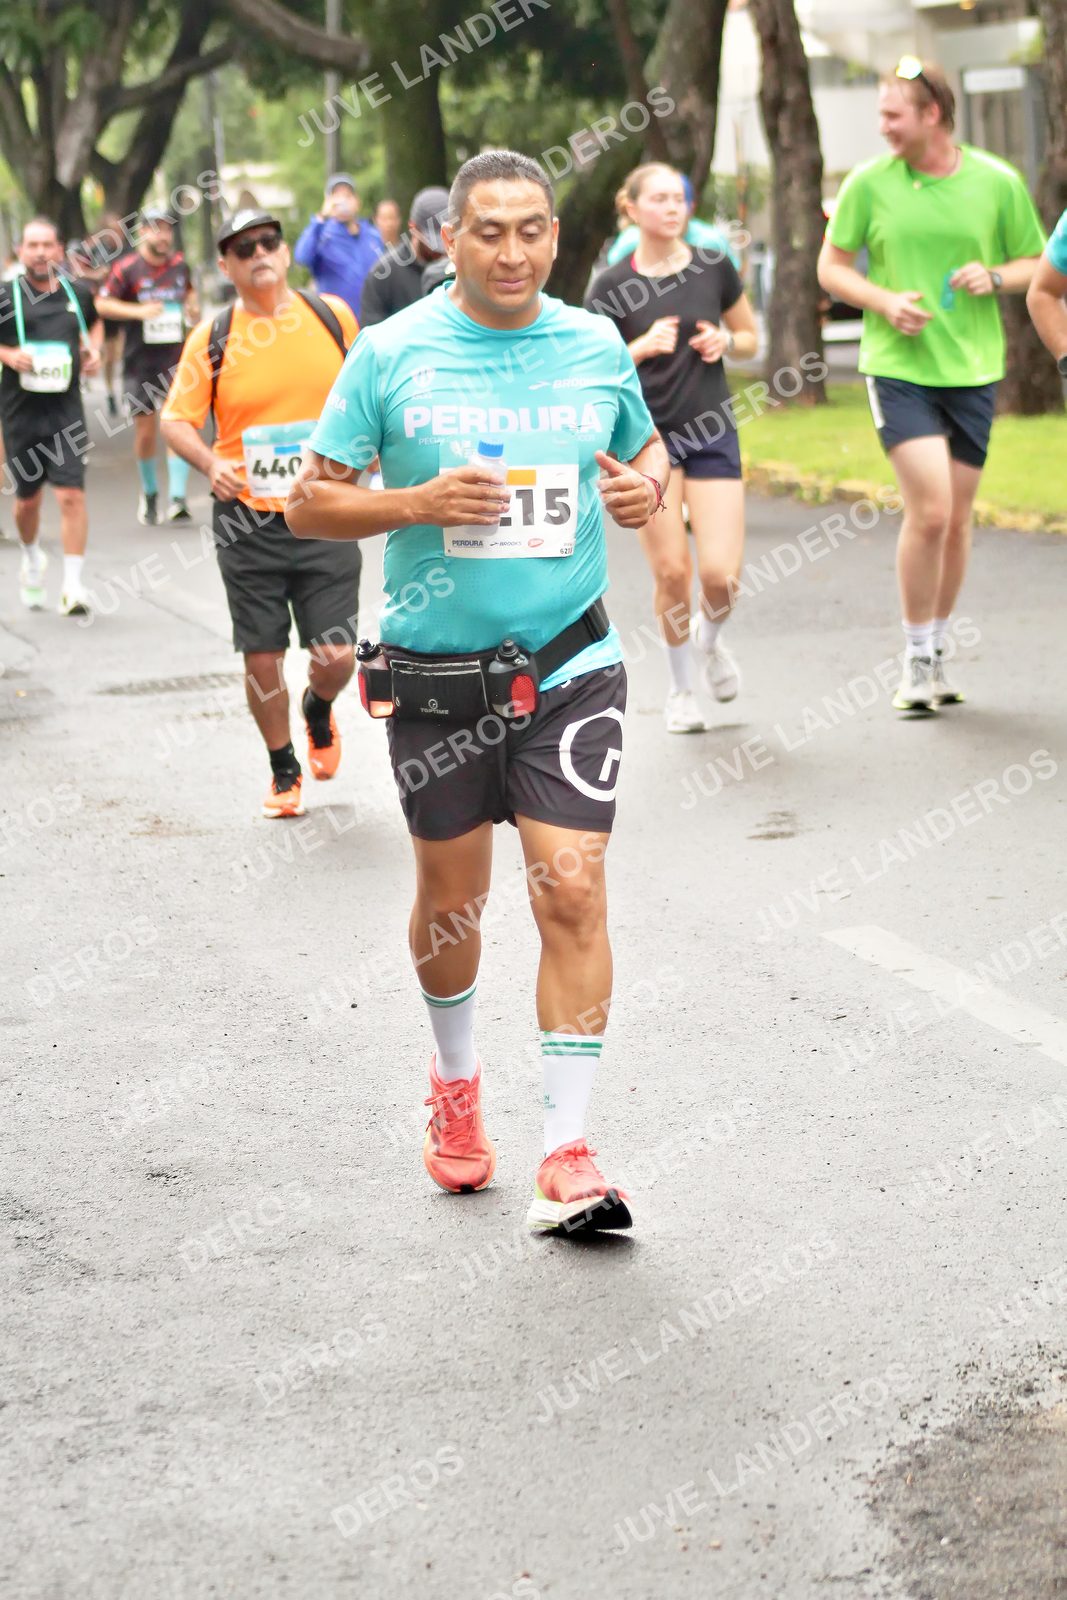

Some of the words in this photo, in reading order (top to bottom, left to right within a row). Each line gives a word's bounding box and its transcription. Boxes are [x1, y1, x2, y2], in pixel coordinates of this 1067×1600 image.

[403, 402, 603, 438] PERDURA
[499, 488, 571, 527] 15
[420, 707, 449, 715] TOPTIME
